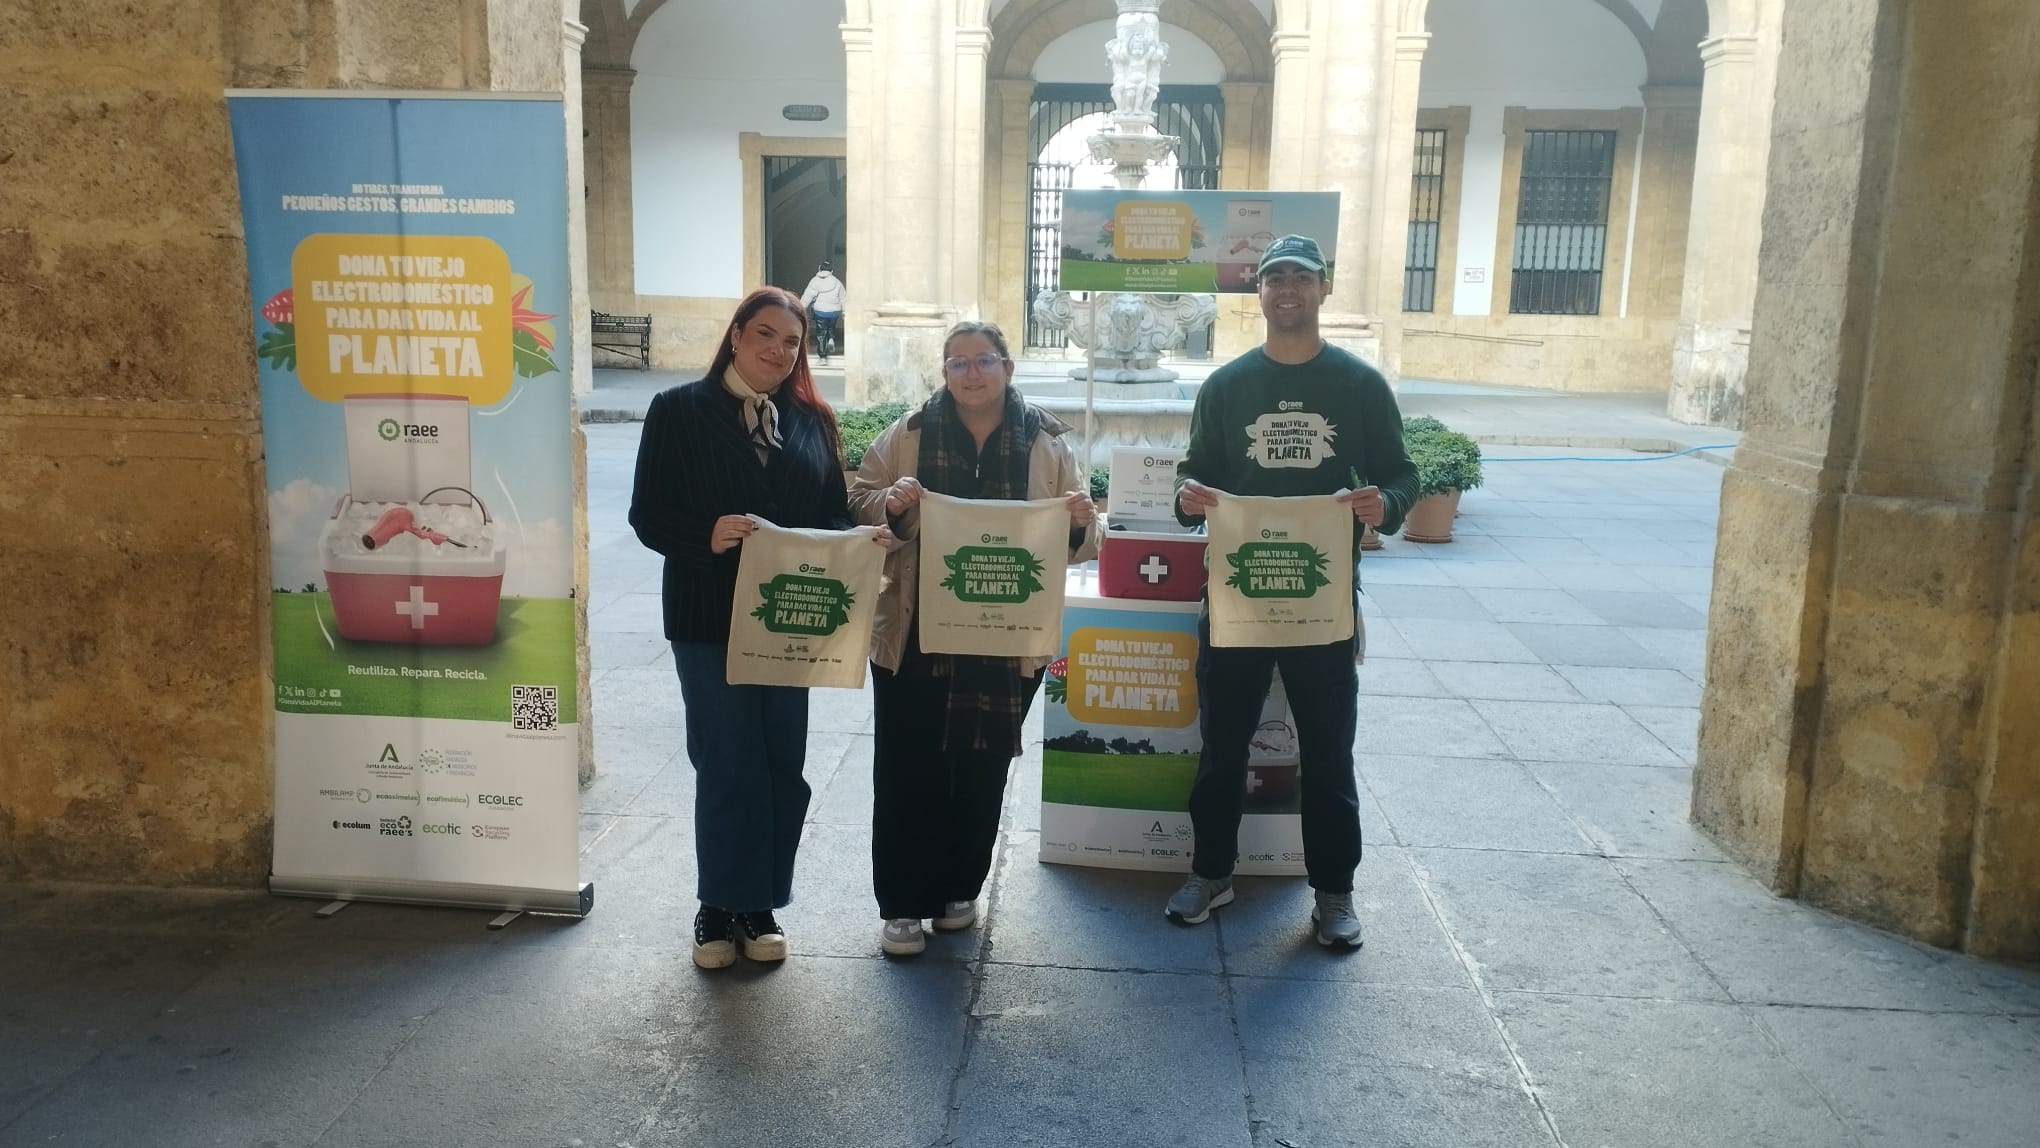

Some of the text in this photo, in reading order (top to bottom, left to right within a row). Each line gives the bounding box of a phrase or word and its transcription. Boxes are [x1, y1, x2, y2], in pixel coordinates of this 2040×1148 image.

[352, 184, 363, 194] NO
[390, 184, 444, 195] TRANSFORMA
[282, 194, 515, 214] PEQUEÑOS GESTOS, GRANDES CAMBIOS
[1124, 235, 1180, 249] PLANETA
[339, 255, 465, 278] DONA TU VIEJO
[312, 280, 494, 305] ELECTRODOMÉSTICO
[326, 307, 482, 332] PARA DAR VIDA AL
[328, 334, 484, 377] PLANETA
[404, 424, 438, 437] raee
[1268, 446, 1311, 460] PLANETA
[786, 583, 830, 595] DONA TU VIEJO
[965, 582, 1019, 595] PLANETA
[1251, 576, 1306, 590] PLANETA
[777, 601, 831, 613] PARA DAR VIDA AL
[774, 610, 827, 628] PLANETA
[1096, 639, 1173, 655] DONA TU VIEJO
[1079, 652, 1190, 671] ELECTRODOMÉSTICO
[347, 665, 487, 680] Reutiliza. Repara. Recicla.
[1086, 668, 1181, 686] PARA DAR VIDA AL
[1085, 684, 1180, 712] PLANETA
[478, 794, 523, 806] ECOLEC
[422, 822, 461, 834] ecotic
[1248, 852, 1275, 861] ecotic
